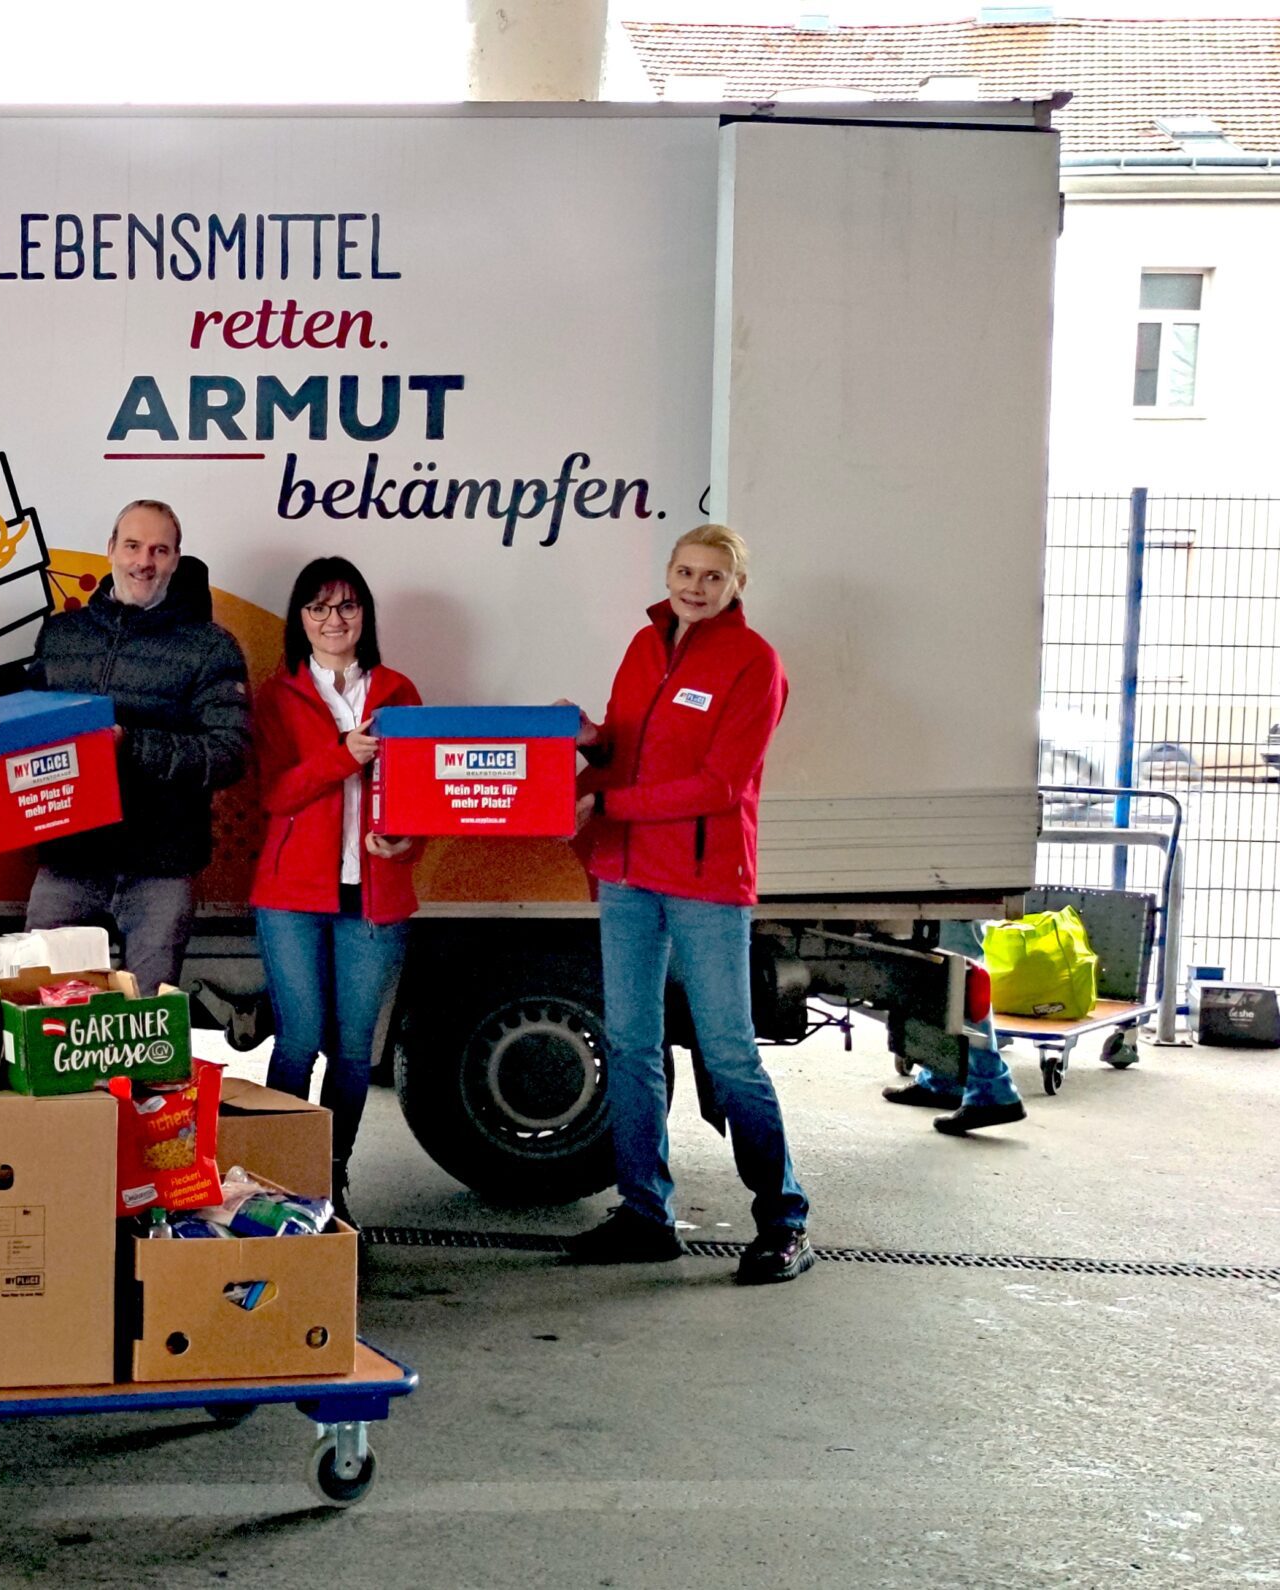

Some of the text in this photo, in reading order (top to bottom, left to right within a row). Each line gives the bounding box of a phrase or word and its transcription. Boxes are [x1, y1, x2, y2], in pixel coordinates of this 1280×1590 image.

[189, 299, 389, 349] retten.
[106, 375, 465, 441] ARMUT
[276, 452, 668, 548] bekämpfen.
[14, 753, 69, 778] MY PLACE
[444, 752, 514, 767] MY PLACE
[18, 784, 75, 808] Mein Platz für
[444, 784, 518, 796] Mein Platz für
[25, 804, 47, 819] mehr
[451, 797, 511, 808] mehr Platz!
[69, 1008, 170, 1046] GÄRTNER
[54, 1042, 148, 1073] Gemüse
[151, 1045, 170, 1057] LGV
